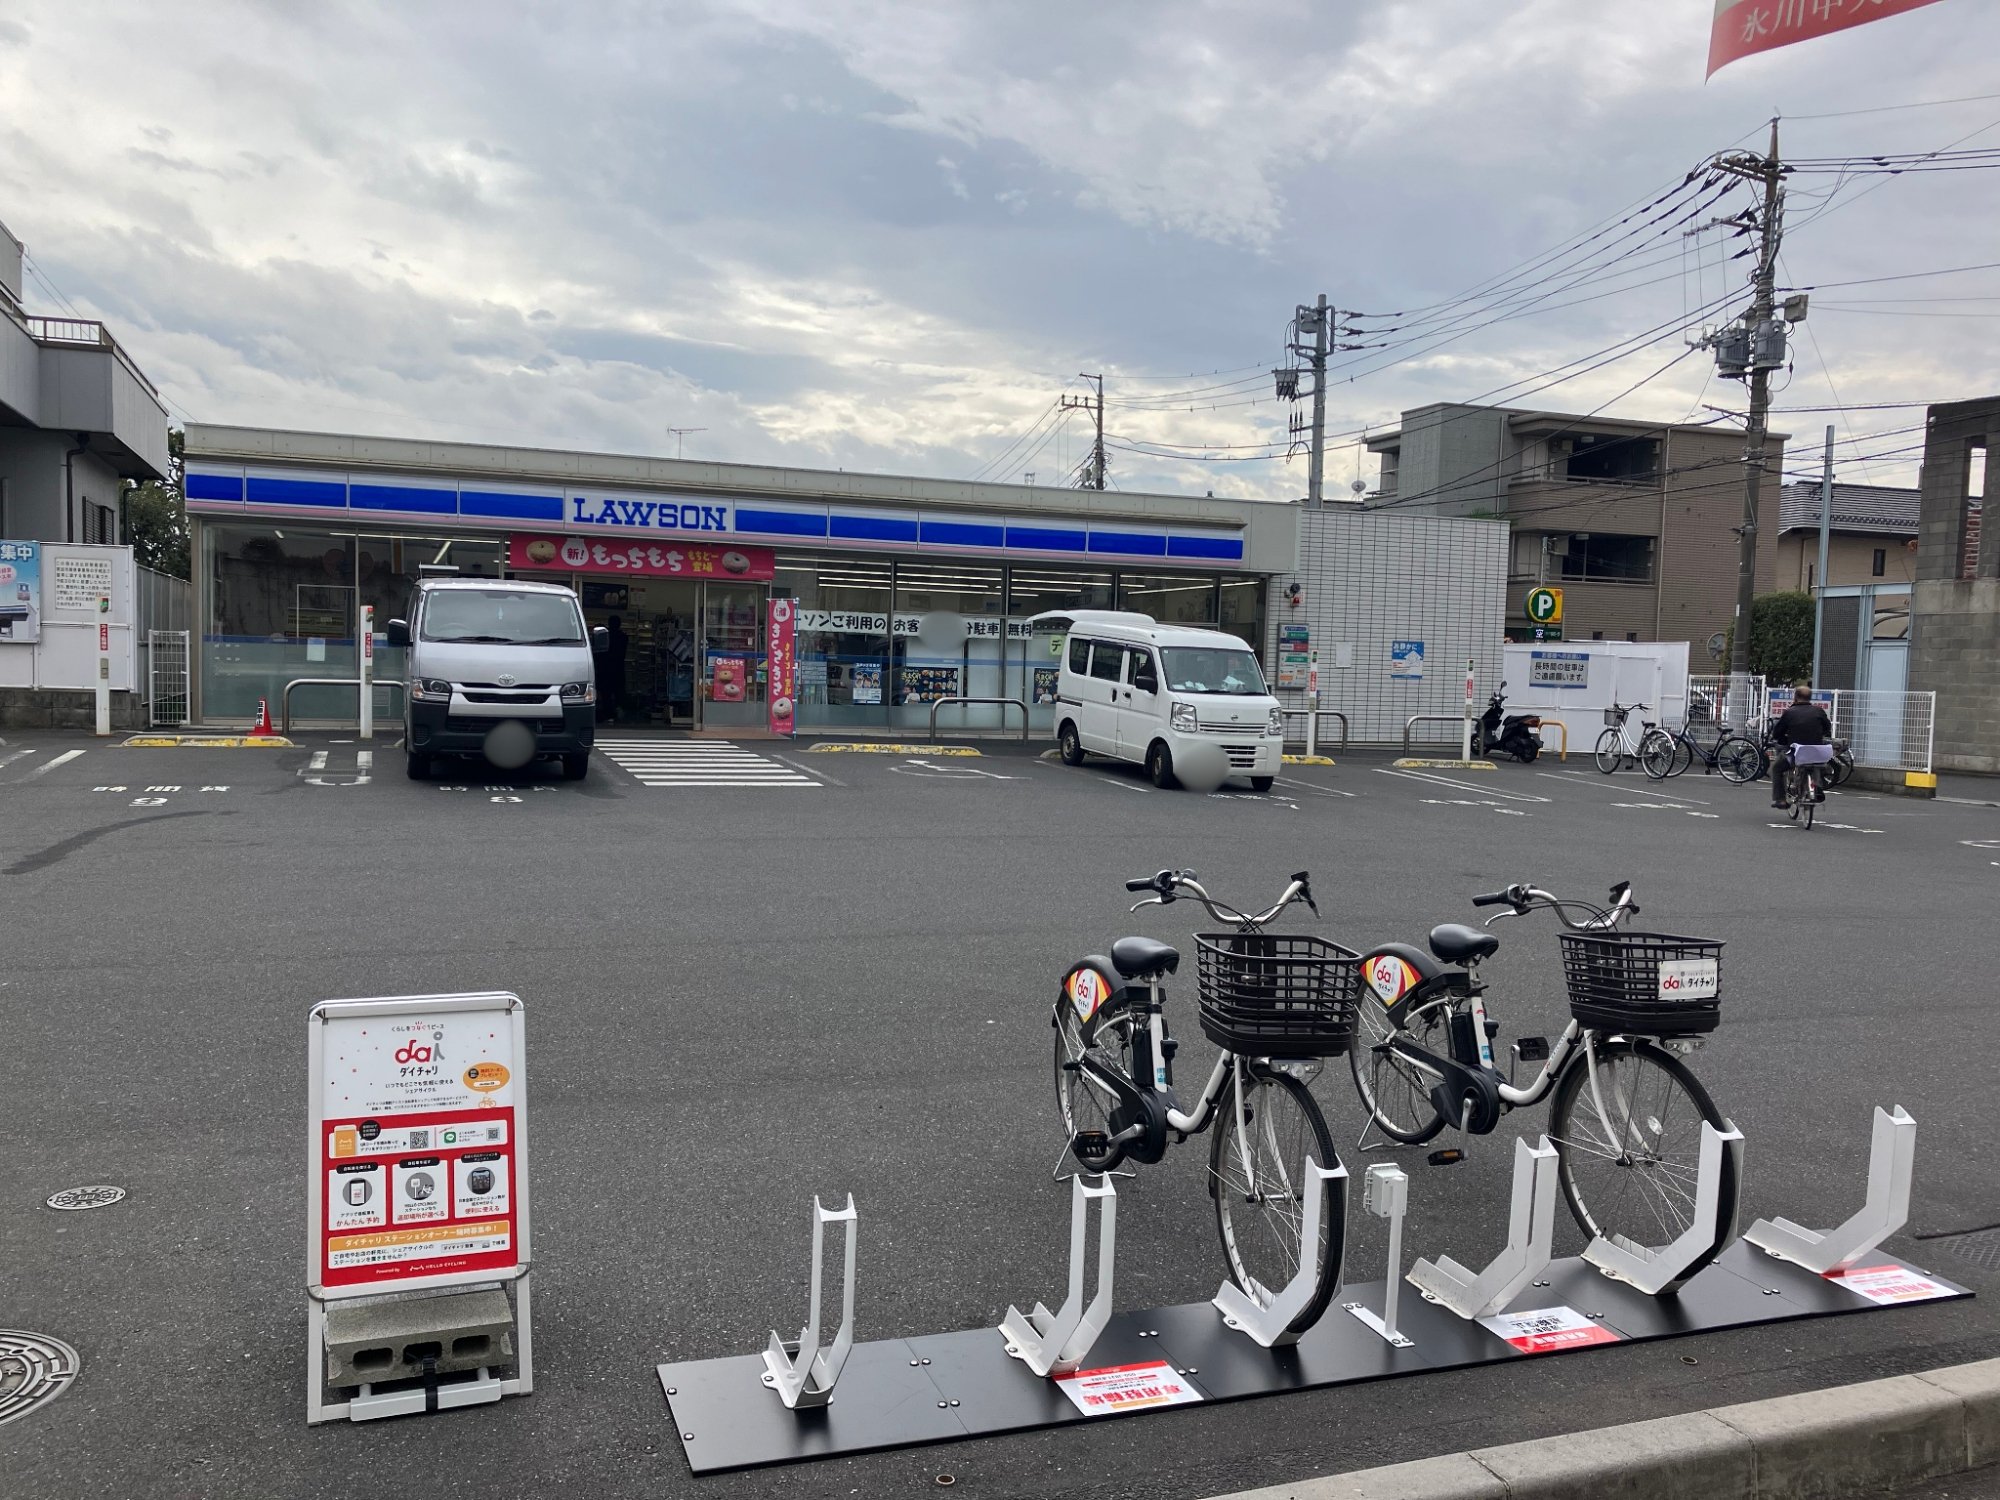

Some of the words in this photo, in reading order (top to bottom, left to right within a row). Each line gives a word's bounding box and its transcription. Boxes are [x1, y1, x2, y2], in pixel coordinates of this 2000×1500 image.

[1741, 0, 1883, 42] 氷川中
[573, 498, 727, 531] LAWSON
[592, 544, 684, 572] もっちもち
[1538, 594, 1553, 617] P
[1534, 662, 1585, 672] 長時間の駐車は
[1534, 672, 1584, 681] ご遠慮願います。
[1687, 976, 1715, 988] ダイチャリ
[395, 1031, 445, 1064] dai
[400, 1065, 439, 1078] ダイチャリ
[385, 1079, 454, 1089] いつでもどこでも気軽に使える
[336, 1216, 380, 1227] かんたん予約
[345, 1236, 382, 1247] ダイチャリ
